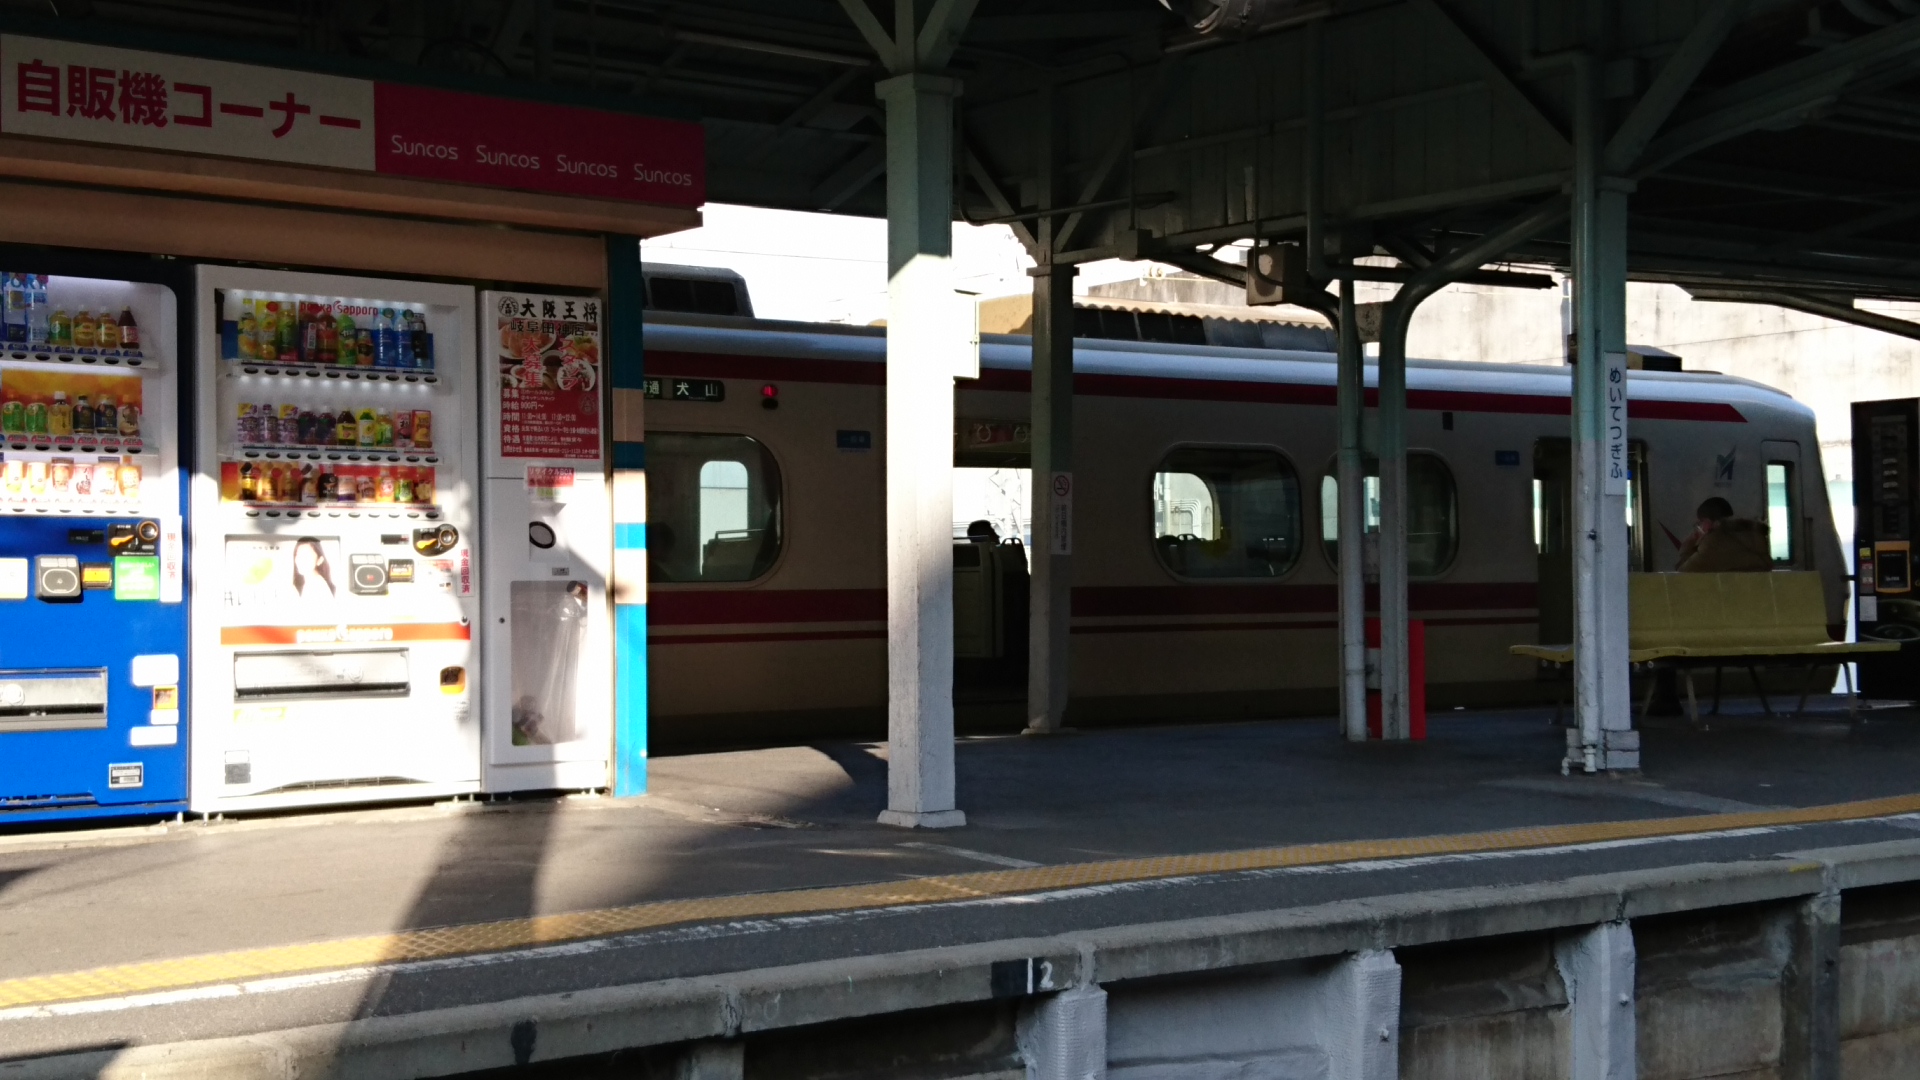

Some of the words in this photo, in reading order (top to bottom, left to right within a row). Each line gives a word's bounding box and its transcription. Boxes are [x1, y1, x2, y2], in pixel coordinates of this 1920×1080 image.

[17, 59, 361, 138] 自販機コーナー
[391, 135, 458, 160] Suncos
[476, 145, 540, 170] Suncos
[557, 155, 618, 178] Suncos
[634, 164, 692, 187] Suncos
[520, 298, 597, 322] 大阪王将
[523, 338, 542, 387] 大募集
[1610, 368, 1622, 479] めいてつぎふ
